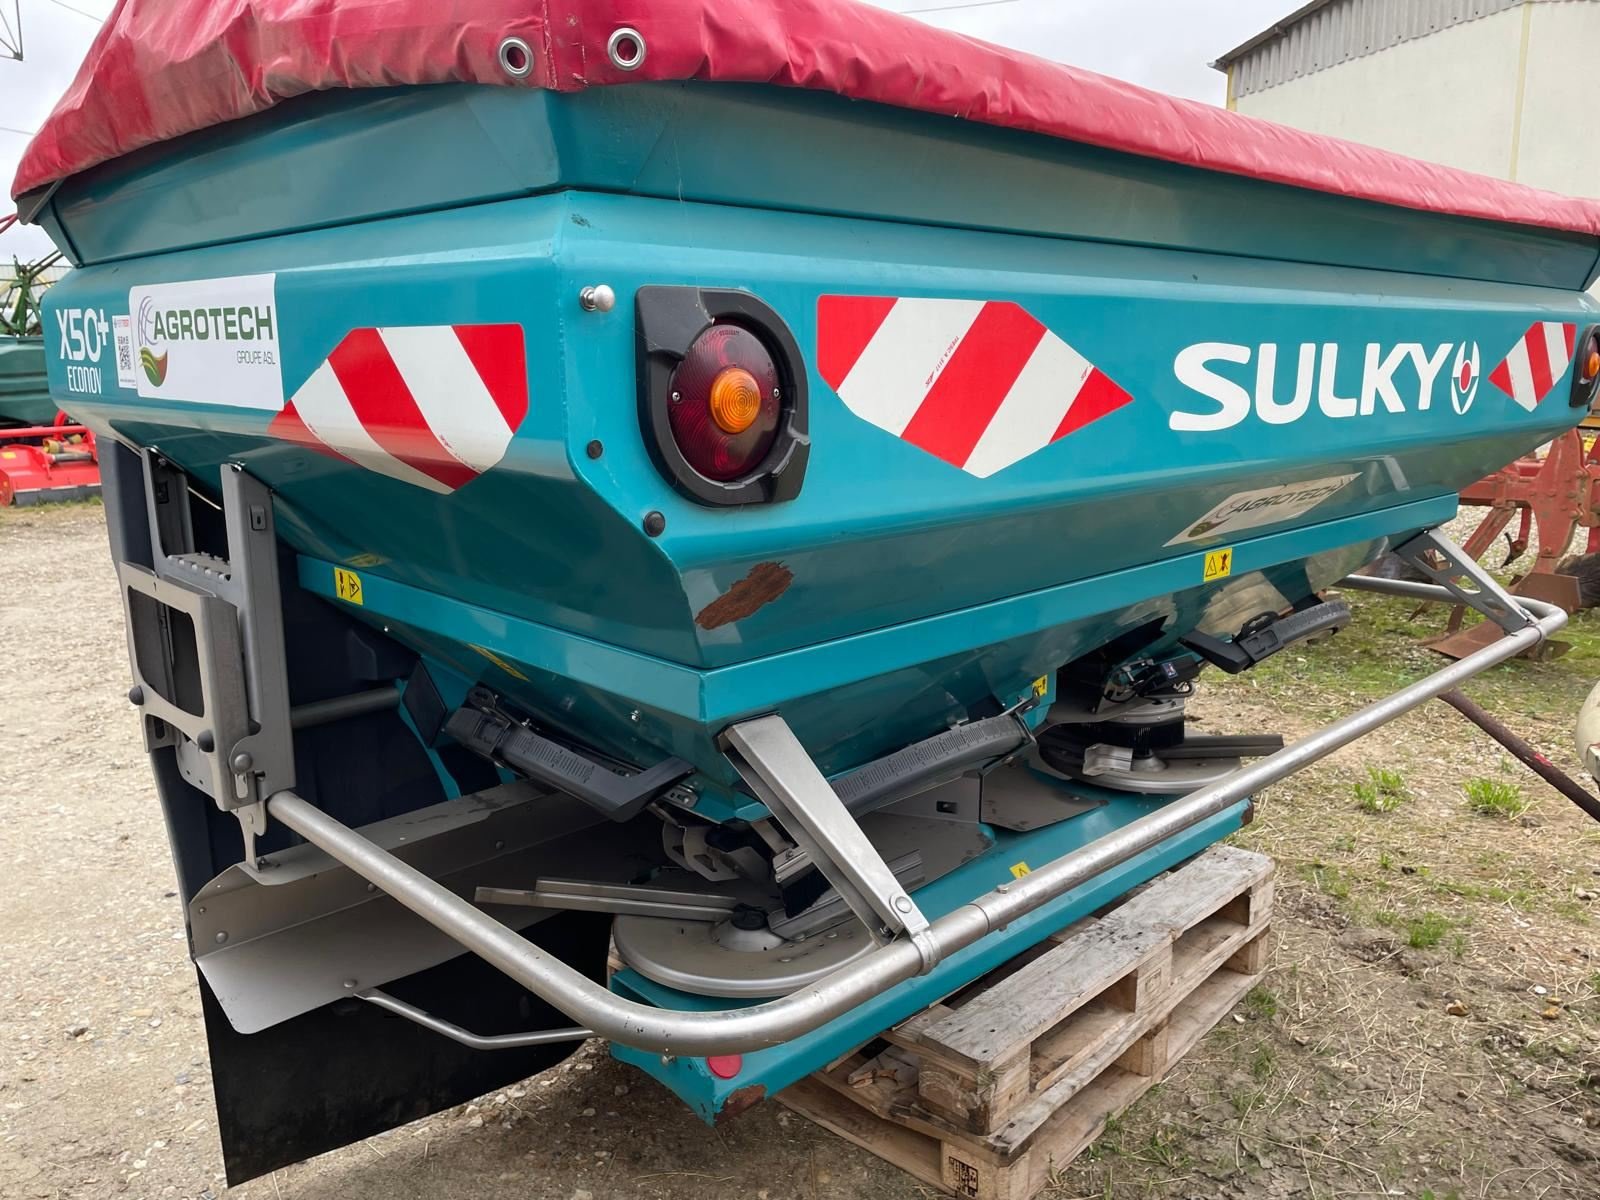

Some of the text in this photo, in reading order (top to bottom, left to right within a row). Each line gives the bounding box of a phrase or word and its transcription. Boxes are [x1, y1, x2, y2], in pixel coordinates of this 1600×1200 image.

[56, 308, 109, 362] X50+
[153, 306, 273, 340] AGROTECH
[237, 350, 277, 365] GROUPE ASL
[1169, 341, 1454, 432] SULKY
[1226, 484, 1342, 515] AGROTECH
